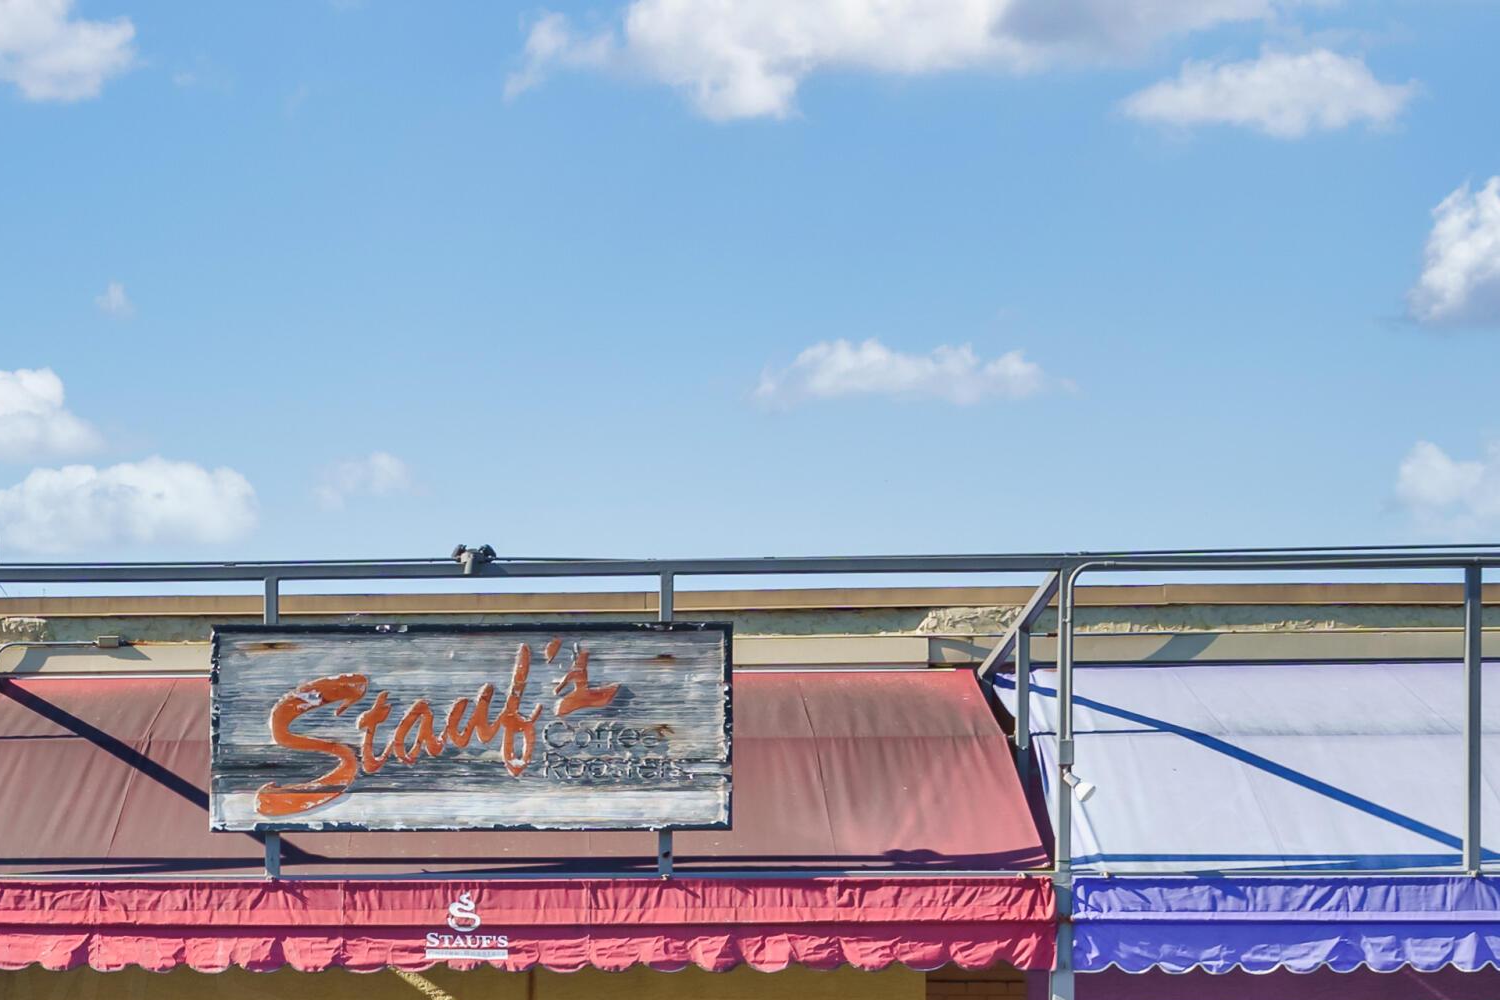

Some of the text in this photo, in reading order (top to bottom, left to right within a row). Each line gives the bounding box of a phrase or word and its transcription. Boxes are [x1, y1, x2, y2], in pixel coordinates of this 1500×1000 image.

[255, 638, 621, 817] Stauf's
[542, 720, 661, 750] Coffee
[543, 751, 684, 779] Roasters
[425, 932, 509, 948] STAUF'S
